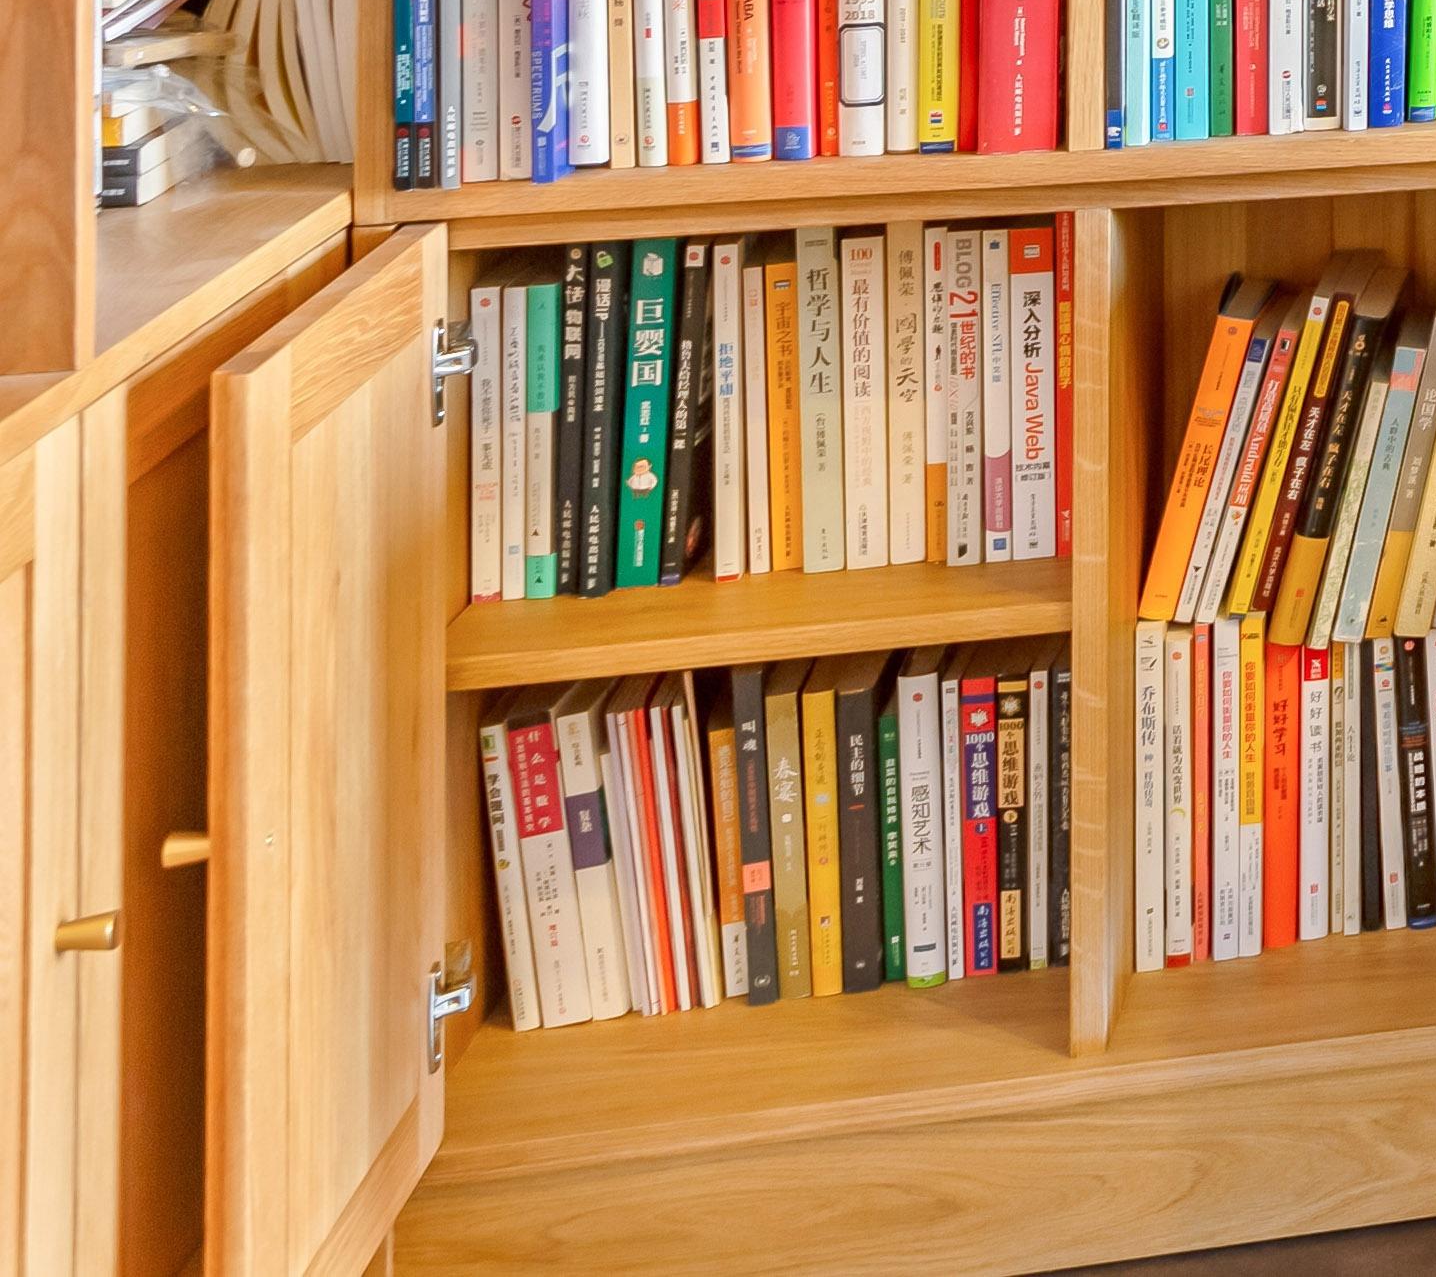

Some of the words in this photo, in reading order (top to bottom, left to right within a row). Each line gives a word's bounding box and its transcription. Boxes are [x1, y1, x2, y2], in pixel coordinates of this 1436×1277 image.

[843, 9, 877, 21] 2018
[631, 298, 666, 388] 巨婴国
[807, 266, 835, 397] 哲学与人生
[851, 278, 872, 399] 最有价值的阅读
[1022, 291, 1041, 359] 深入分析
[1024, 361, 1042, 410] Java
[1024, 416, 1041, 460] Web
[1141, 686, 1158, 744] 乔布斯传
[849, 734, 865, 797] 民主的细节
[911, 785, 932, 855] 感知艺术
